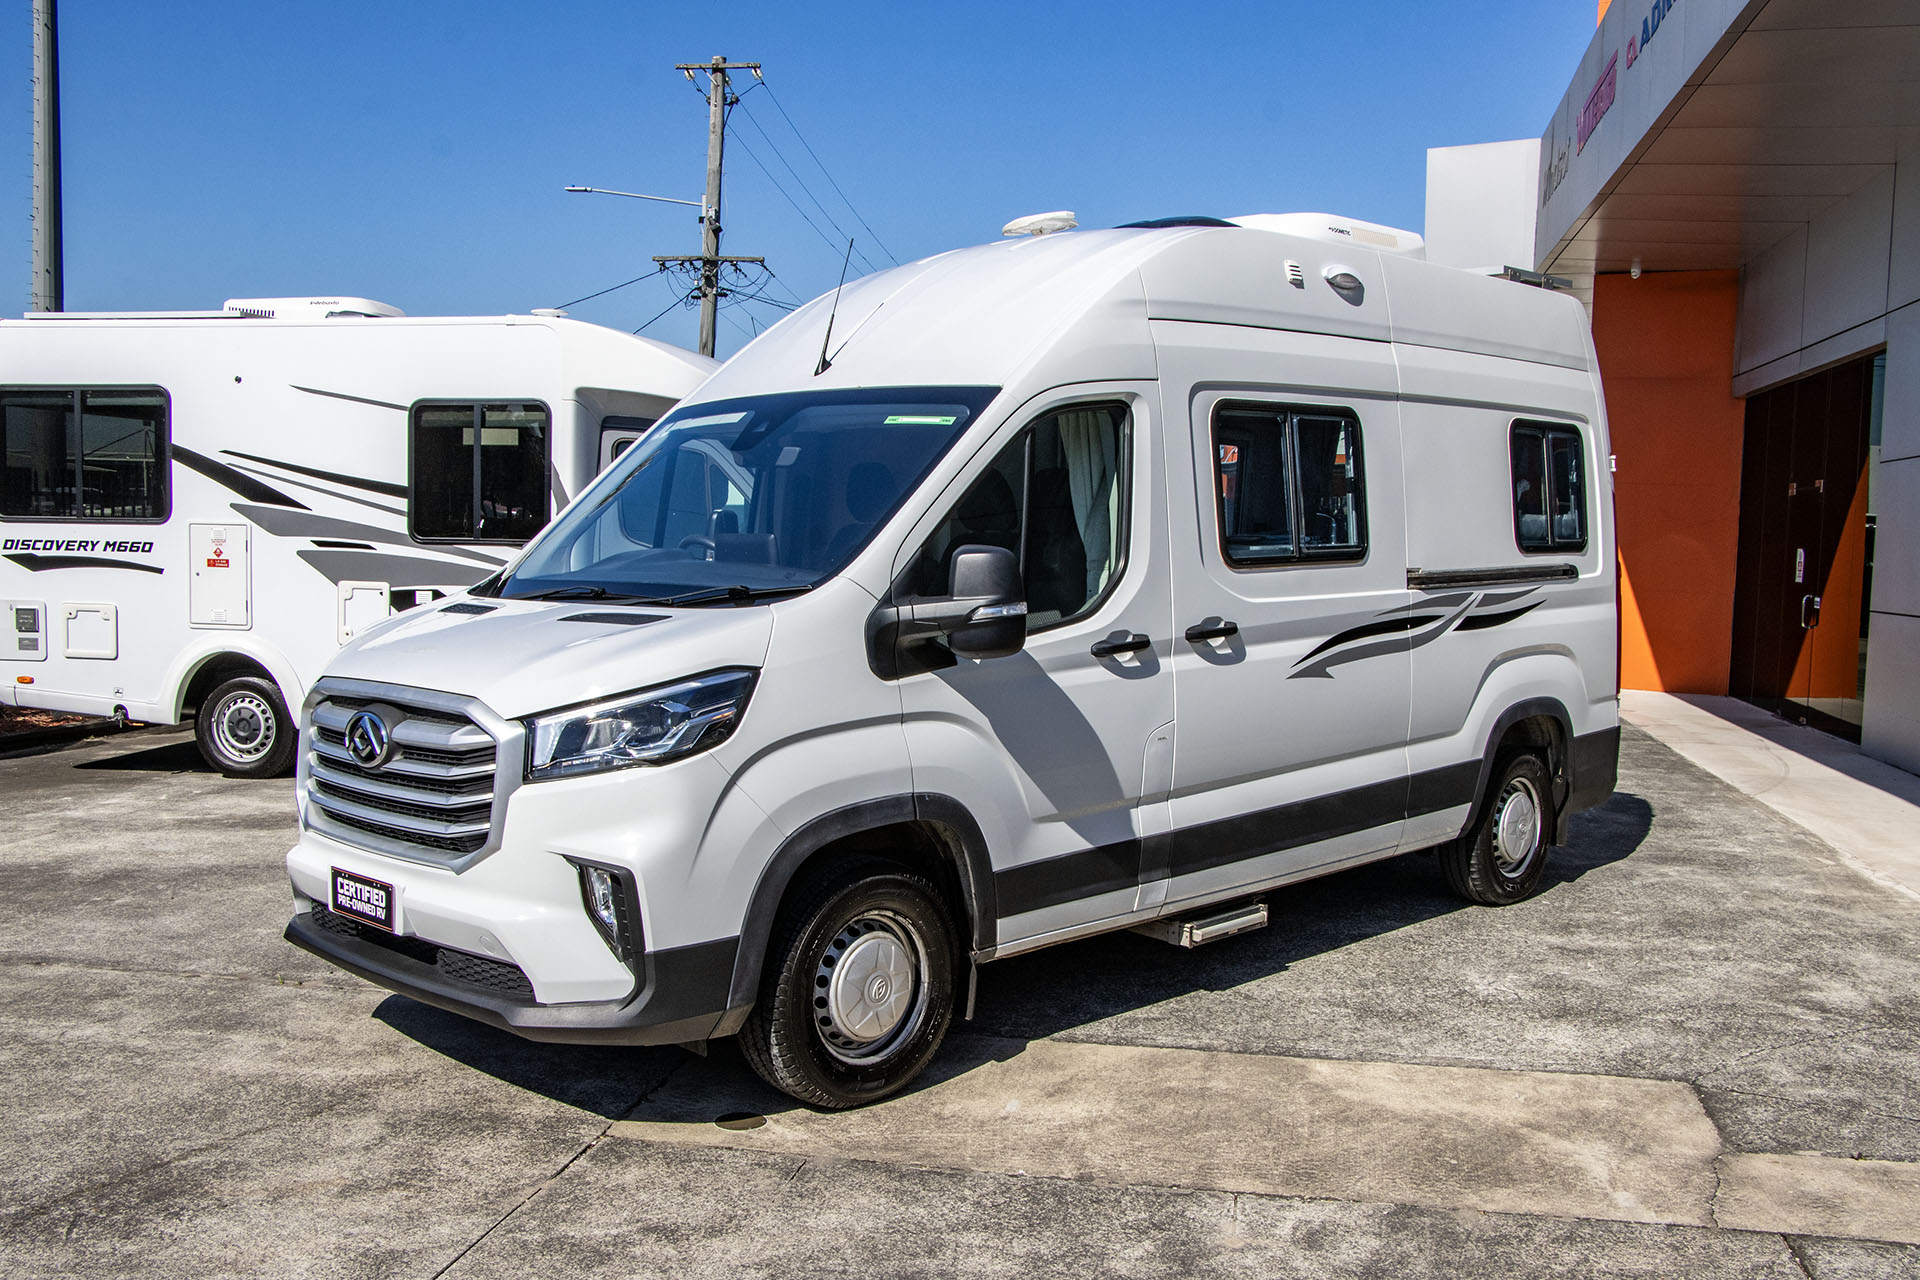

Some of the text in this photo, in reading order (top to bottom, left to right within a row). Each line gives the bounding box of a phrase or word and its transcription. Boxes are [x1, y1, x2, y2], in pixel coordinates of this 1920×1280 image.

[2, 538, 155, 553] DISCOVERY M660
[337, 876, 386, 908] CERTIFIED
[337, 893, 386, 920] PRE-OWNED RV
